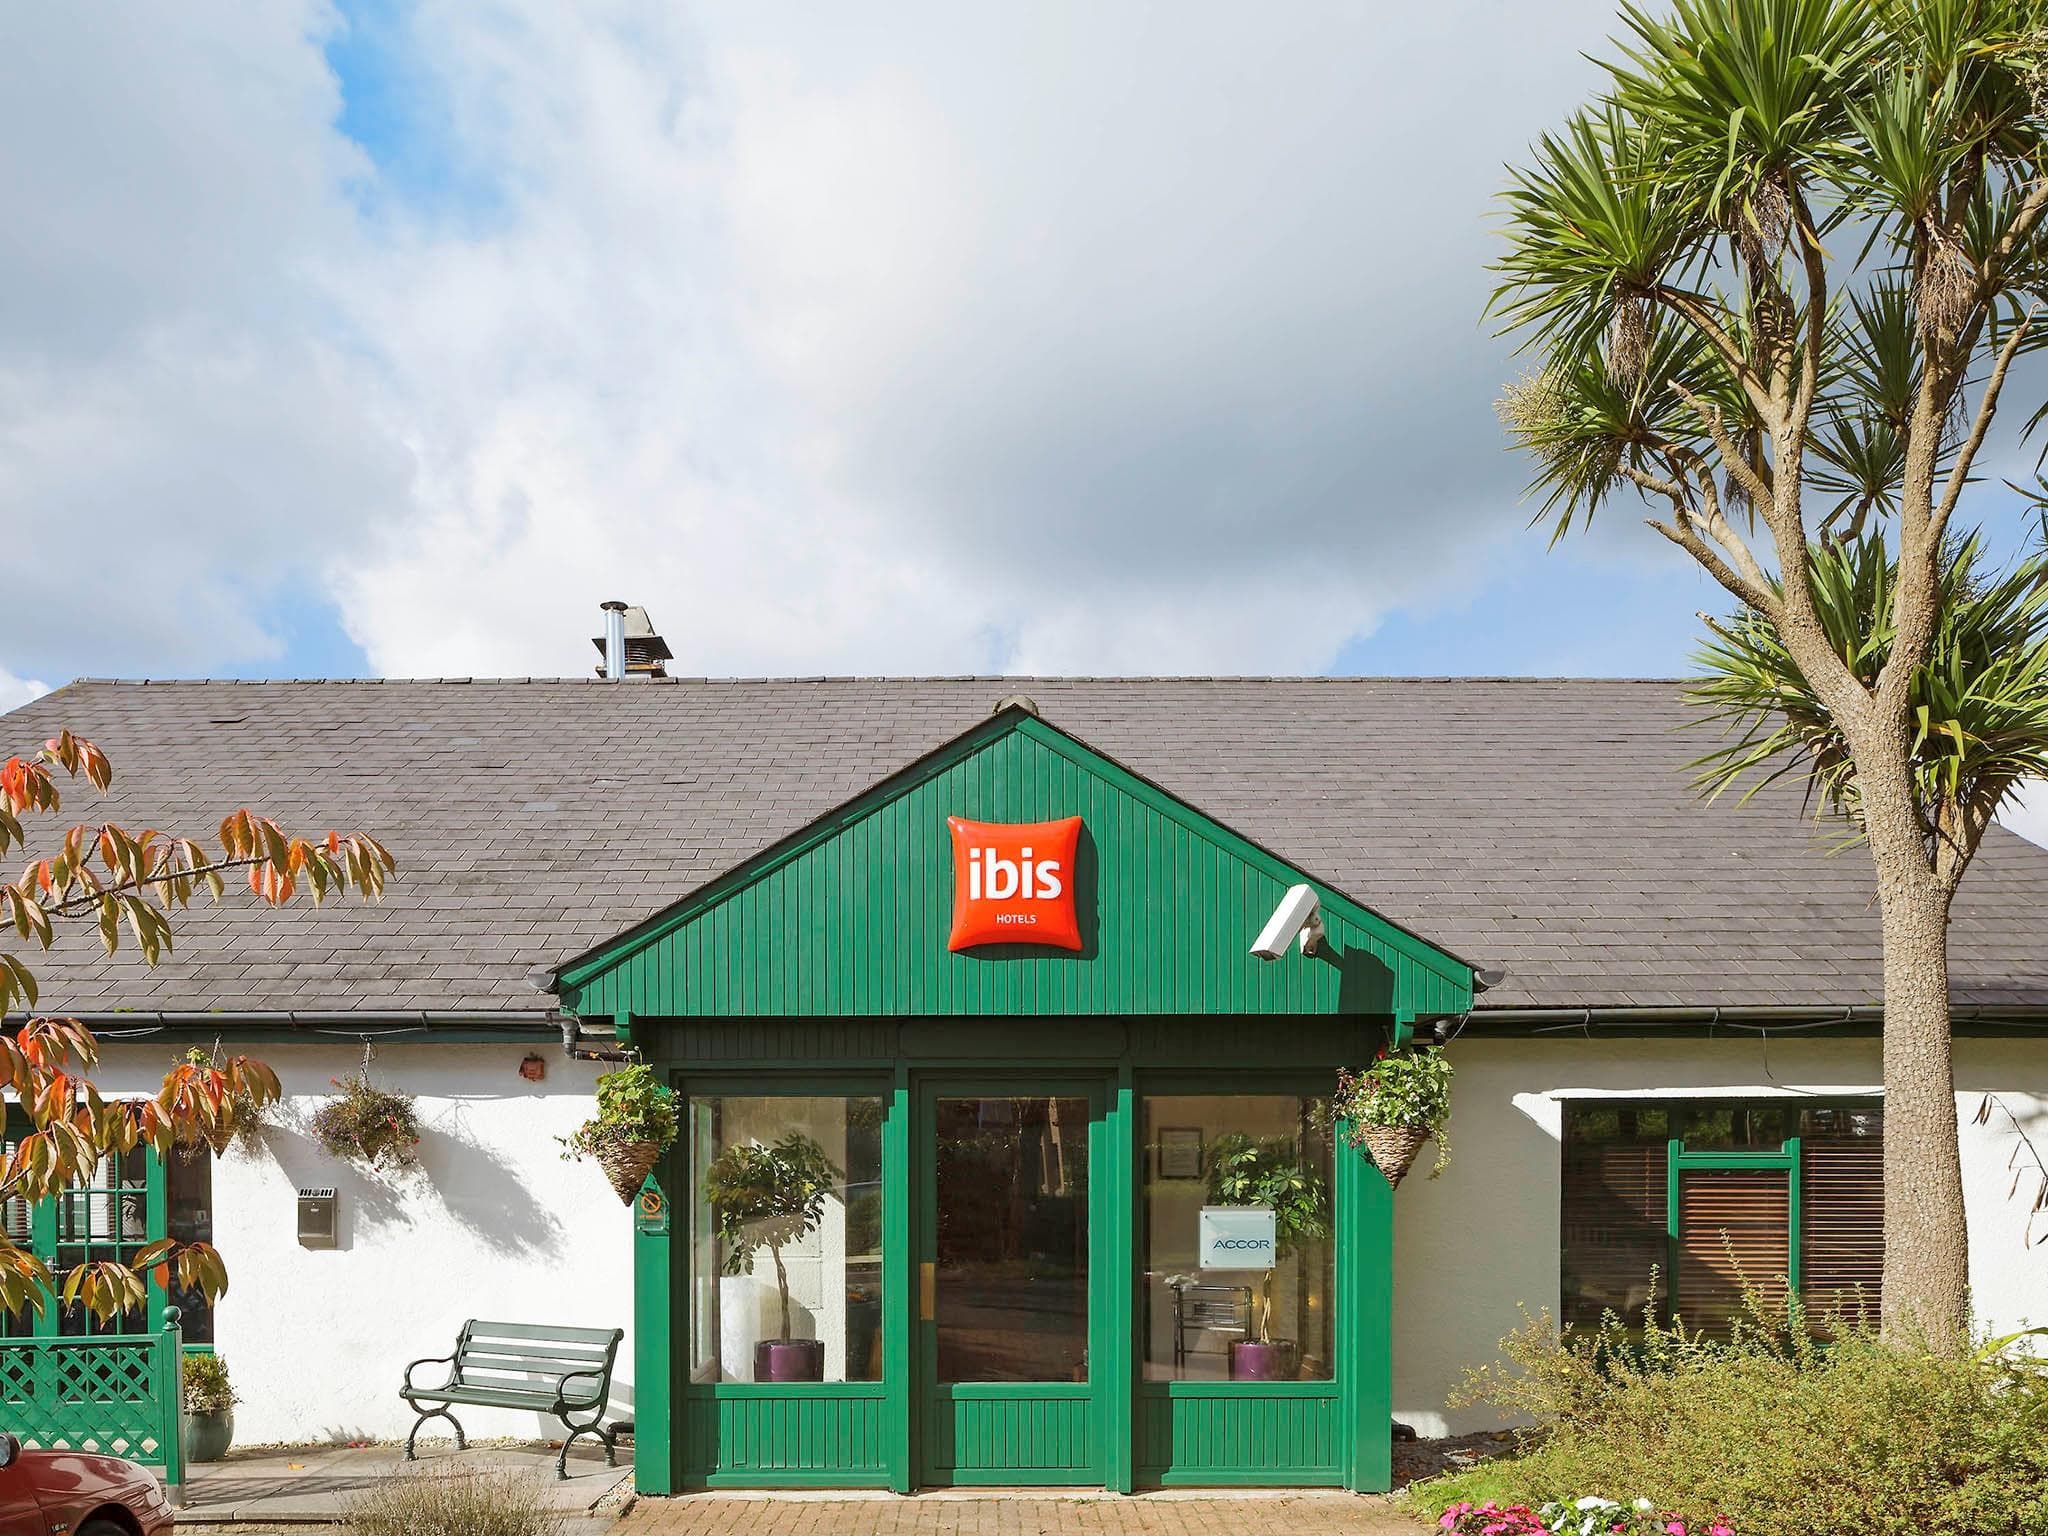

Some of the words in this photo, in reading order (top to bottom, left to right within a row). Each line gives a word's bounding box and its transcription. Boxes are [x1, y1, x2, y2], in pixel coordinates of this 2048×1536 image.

[970, 847, 1062, 900] ibis
[996, 914, 1037, 924] HOTELS
[1213, 1240, 1270, 1249] ACCOR
